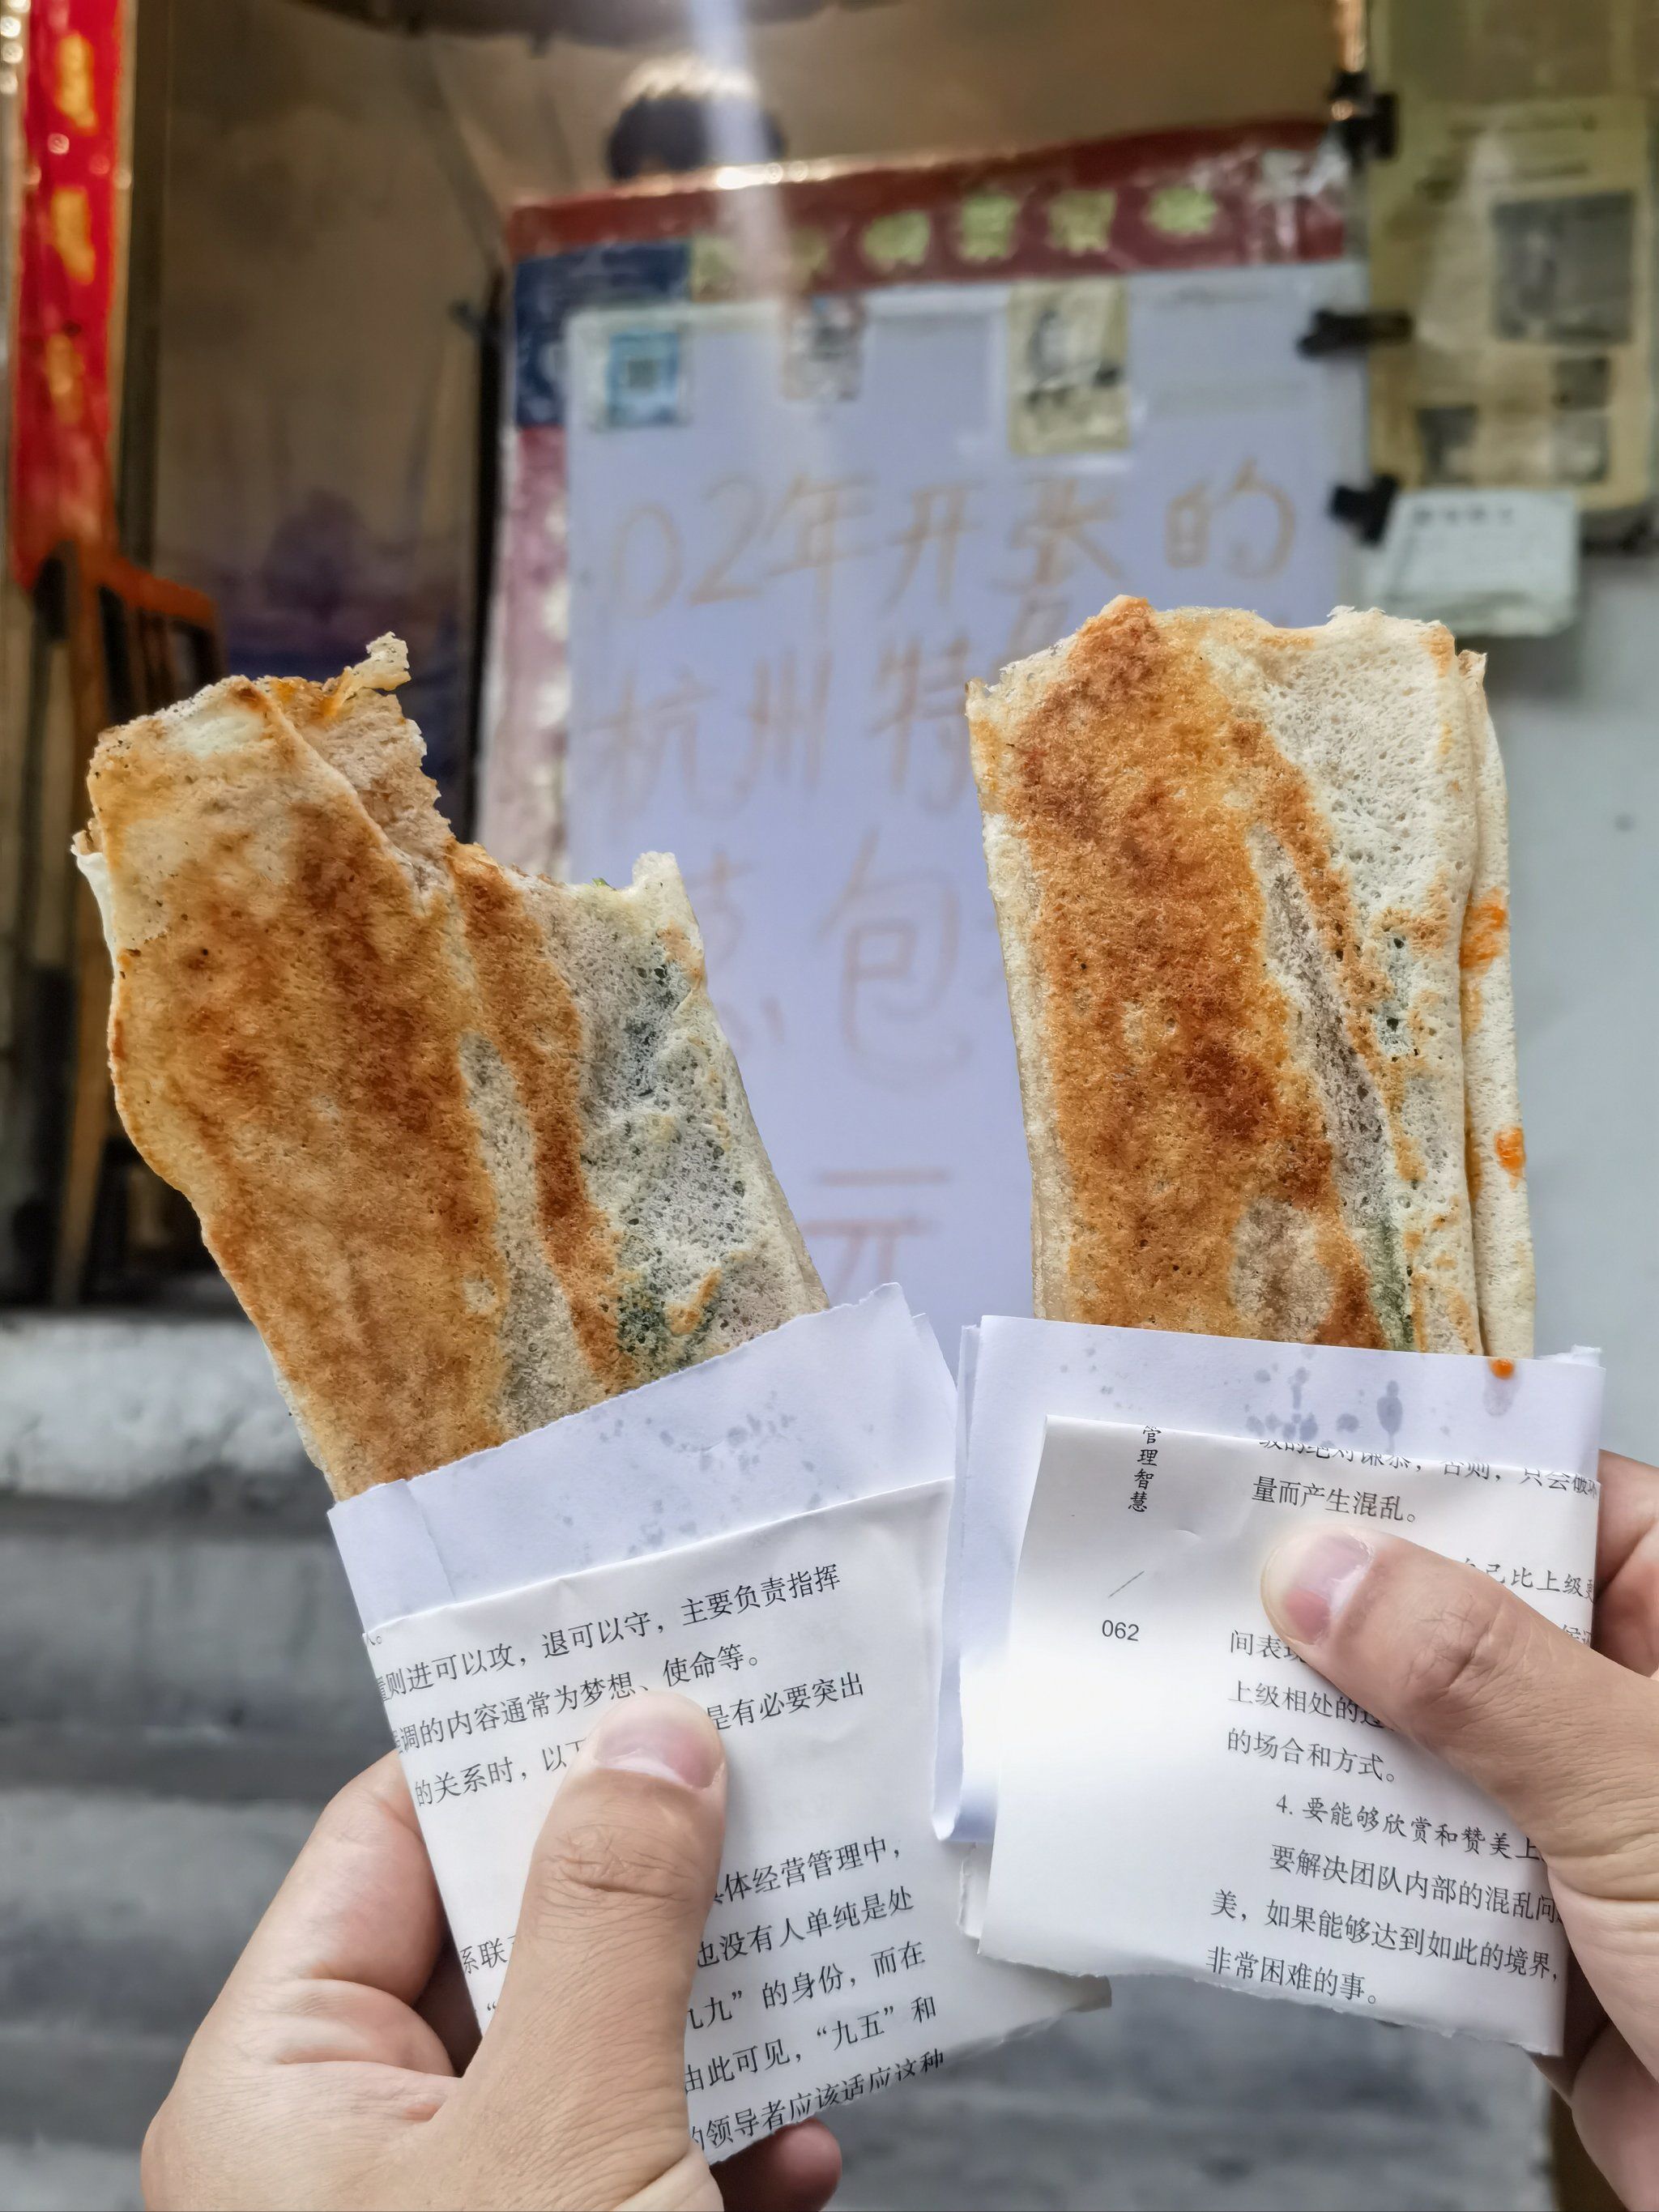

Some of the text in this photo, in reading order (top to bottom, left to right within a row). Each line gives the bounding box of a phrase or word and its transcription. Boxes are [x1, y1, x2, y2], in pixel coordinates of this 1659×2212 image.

[1128, 1426, 1162, 1512] 管理智慧
[1252, 1476, 1416, 1523] 量而产生混乱。
[1102, 1619, 1140, 1642] 062
[1227, 1728, 1394, 1782] 的场合和方式。
[1276, 1794, 1546, 1863] 4.要能够欣赏和赞美上
[460, 1836, 900, 1974] 系联 体经营管理中，
[1269, 1843, 1563, 1925] 要解决团队内部的混乱问
[1205, 1946, 1376, 2005] 非常困难的事。
